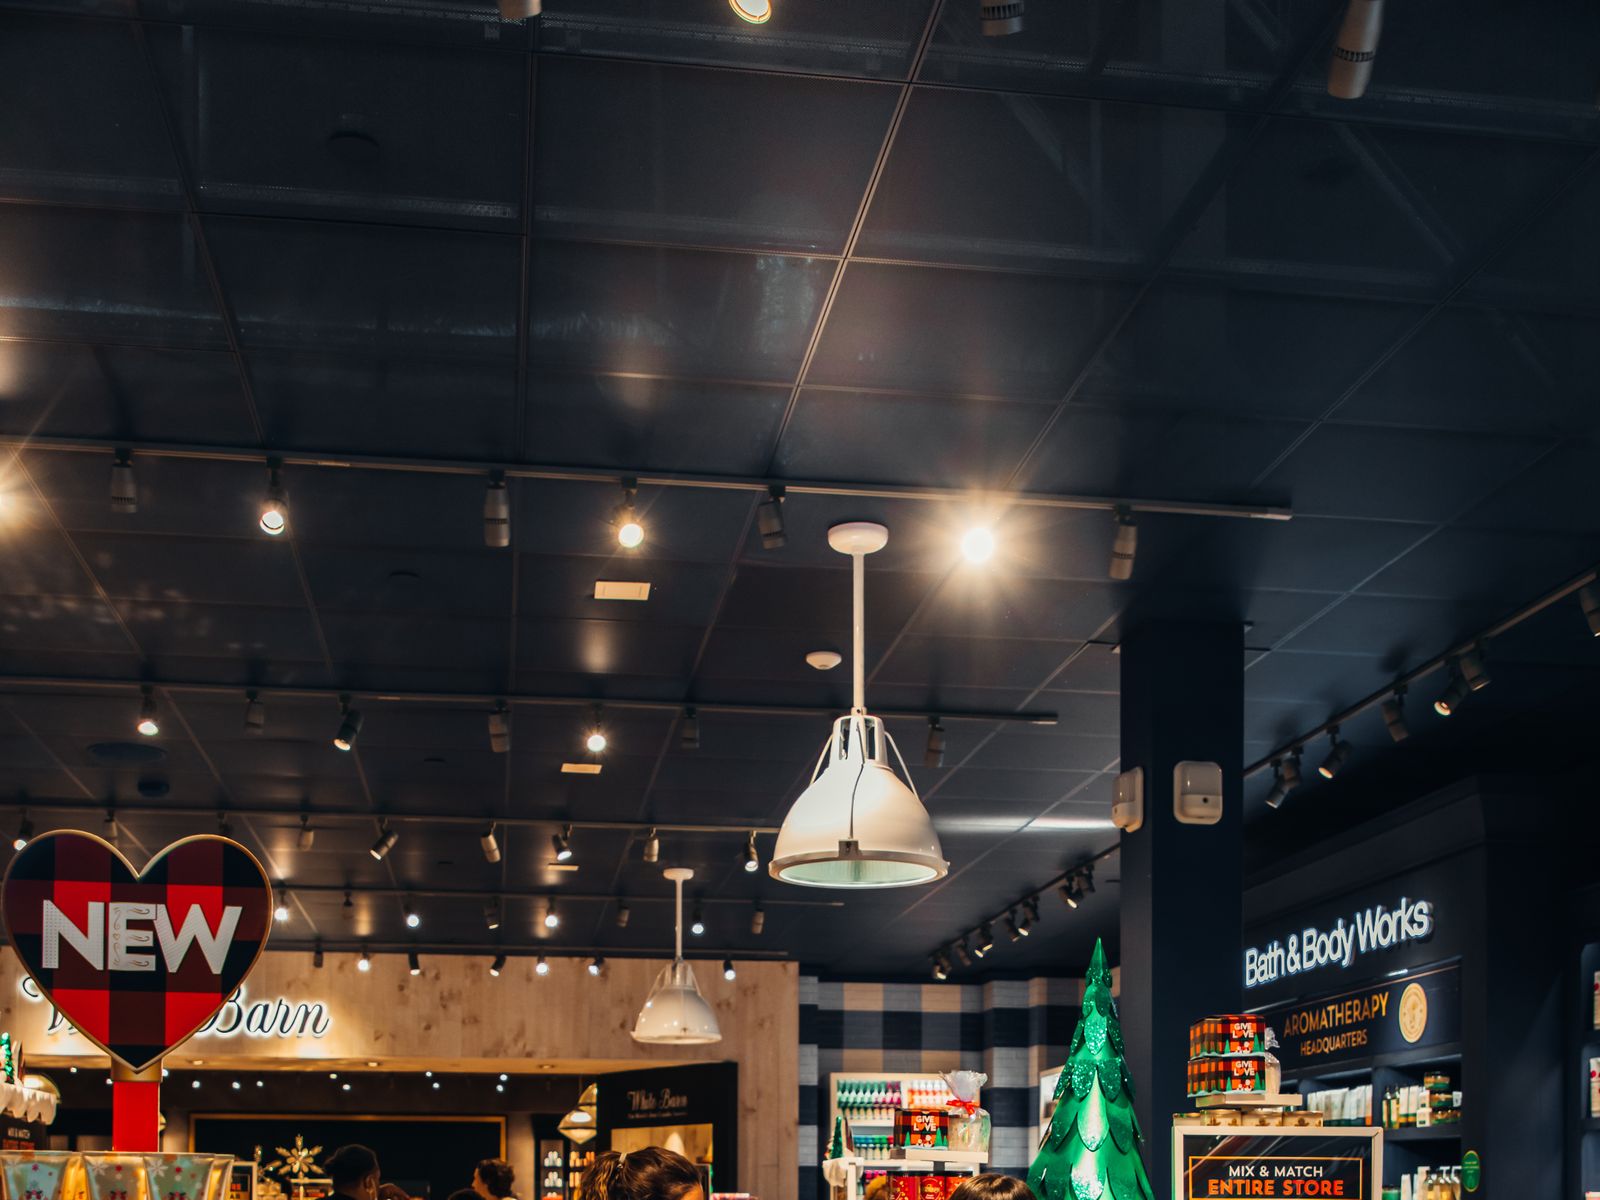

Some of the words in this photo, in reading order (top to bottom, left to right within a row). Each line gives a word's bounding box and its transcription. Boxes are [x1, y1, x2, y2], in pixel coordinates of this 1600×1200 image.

[42, 900, 242, 975] NEW
[1245, 940, 1286, 986] Bath
[1286, 934, 1301, 975] &
[1302, 917, 1355, 968] Body
[1355, 897, 1430, 954] Works
[1283, 991, 1389, 1037] AROMATHERAPY
[1234, 1022, 1253, 1030] GIVE
[1300, 1029, 1368, 1056] HEADQUARTERS
[1235, 1060, 1253, 1068] GIVE
[915, 1115, 935, 1123] GIVE
[1228, 1165, 1255, 1177] MIX
[1259, 1166, 1269, 1177] &
[1274, 1166, 1323, 1177] MATCH
[1208, 1179, 1275, 1195] ENTIRE
[1282, 1180, 1344, 1196] STORE
